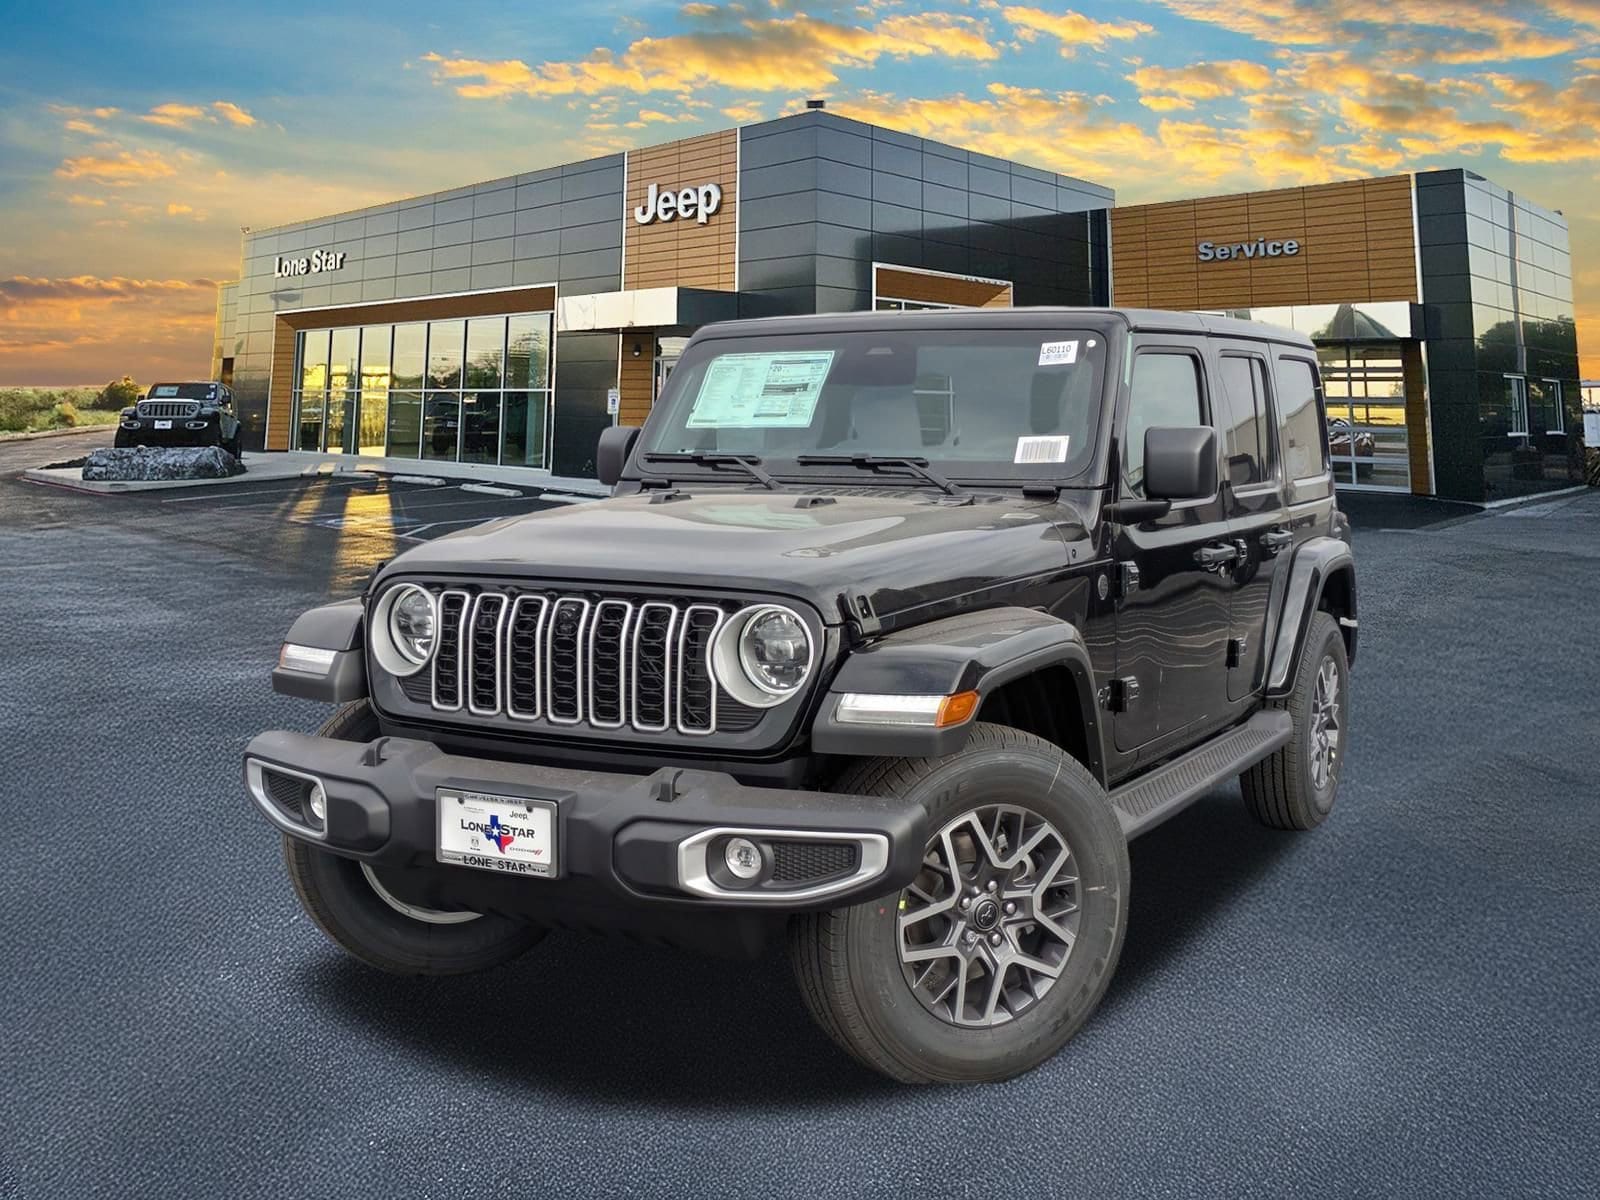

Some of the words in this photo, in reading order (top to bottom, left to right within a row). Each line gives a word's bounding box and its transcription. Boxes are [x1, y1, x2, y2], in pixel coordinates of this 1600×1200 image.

[634, 183, 721, 225] Jeep
[1198, 236, 1300, 261] Service
[274, 256, 309, 279] Lone
[311, 249, 346, 273] Star
[1041, 344, 1072, 355] L60110
[509, 810, 528, 821] Jeep
[460, 818, 492, 833] LONE
[500, 824, 536, 839] STAR
[463, 855, 493, 868] LONE
[497, 860, 527, 873] STAR
